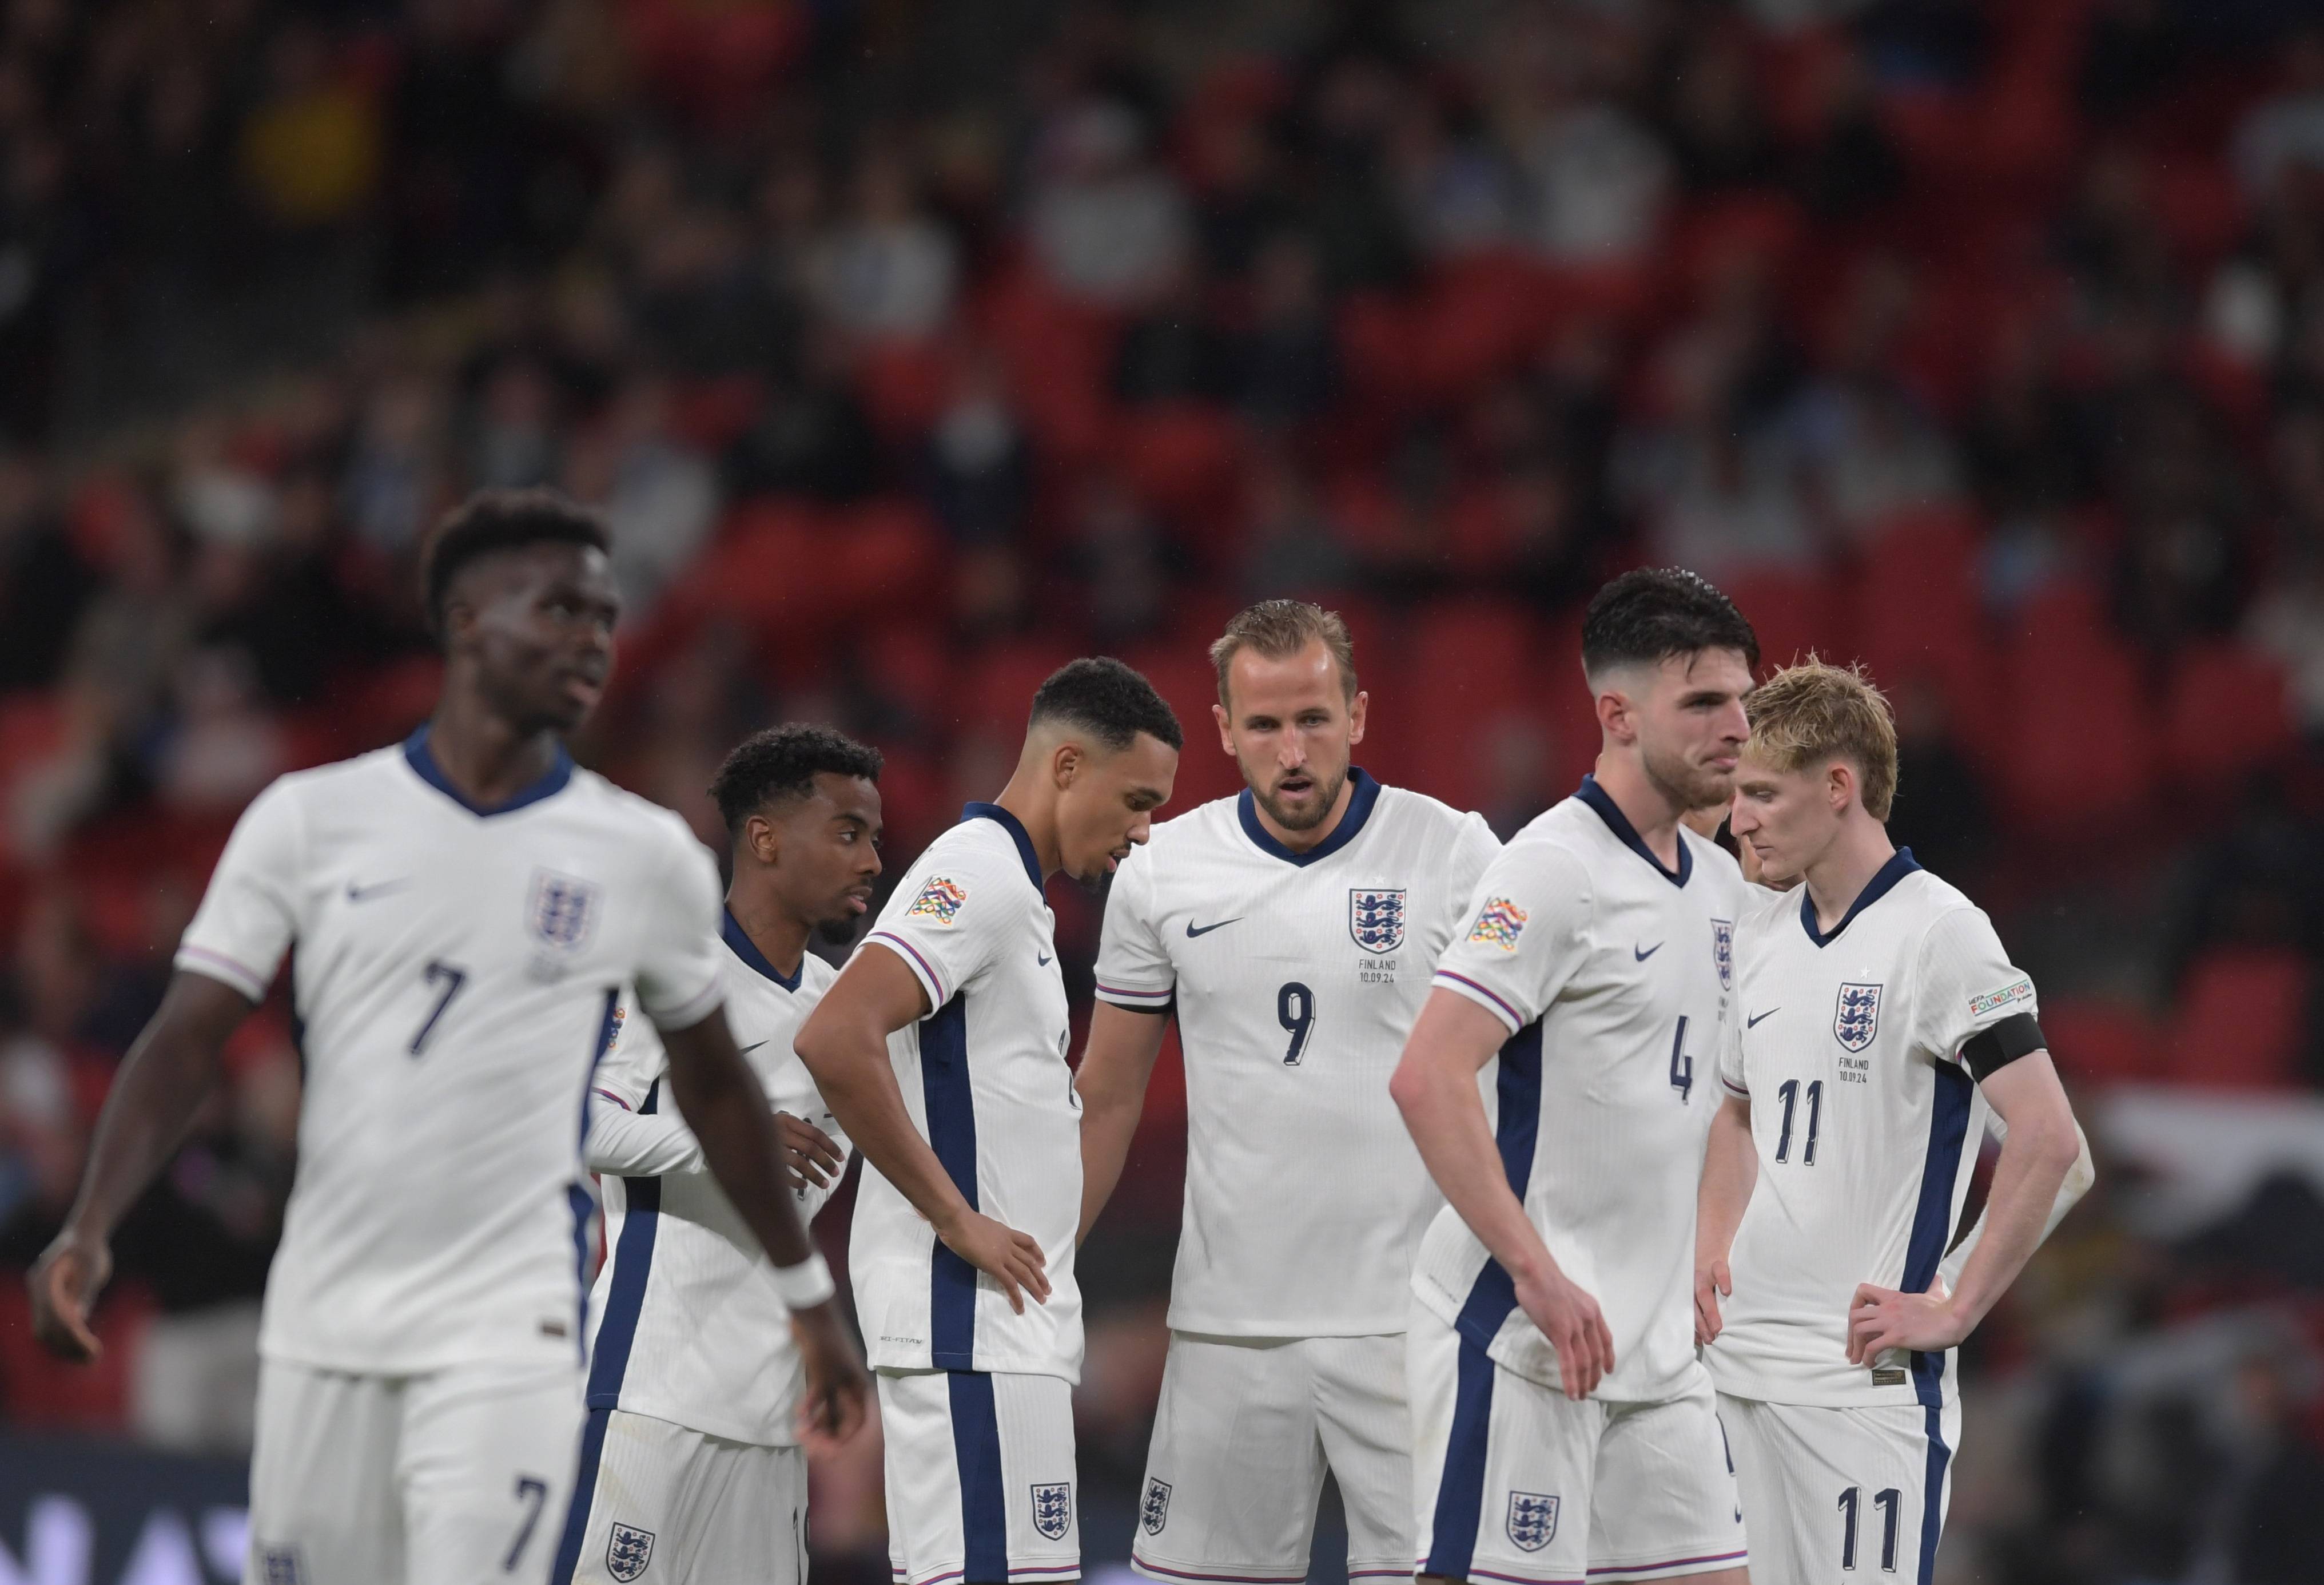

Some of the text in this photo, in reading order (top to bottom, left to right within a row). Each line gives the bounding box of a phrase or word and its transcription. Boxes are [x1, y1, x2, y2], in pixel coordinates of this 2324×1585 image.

[1359, 959, 1396, 970] FINLAND
[1360, 972, 1394, 983] 10.09.24
[1971, 982, 2031, 1014] FOUNDATION
[408, 962, 466, 1054] 7
[1278, 982, 1315, 1066] 9
[1670, 1015, 1693, 1105] 4
[1838, 1057, 1869, 1070] FINLAND
[1840, 1071, 1867, 1083] 10.09.24
[1776, 1079, 1824, 1166] 11
[503, 1477, 547, 1571] 7
[1838, 1487, 1902, 1573] 11
